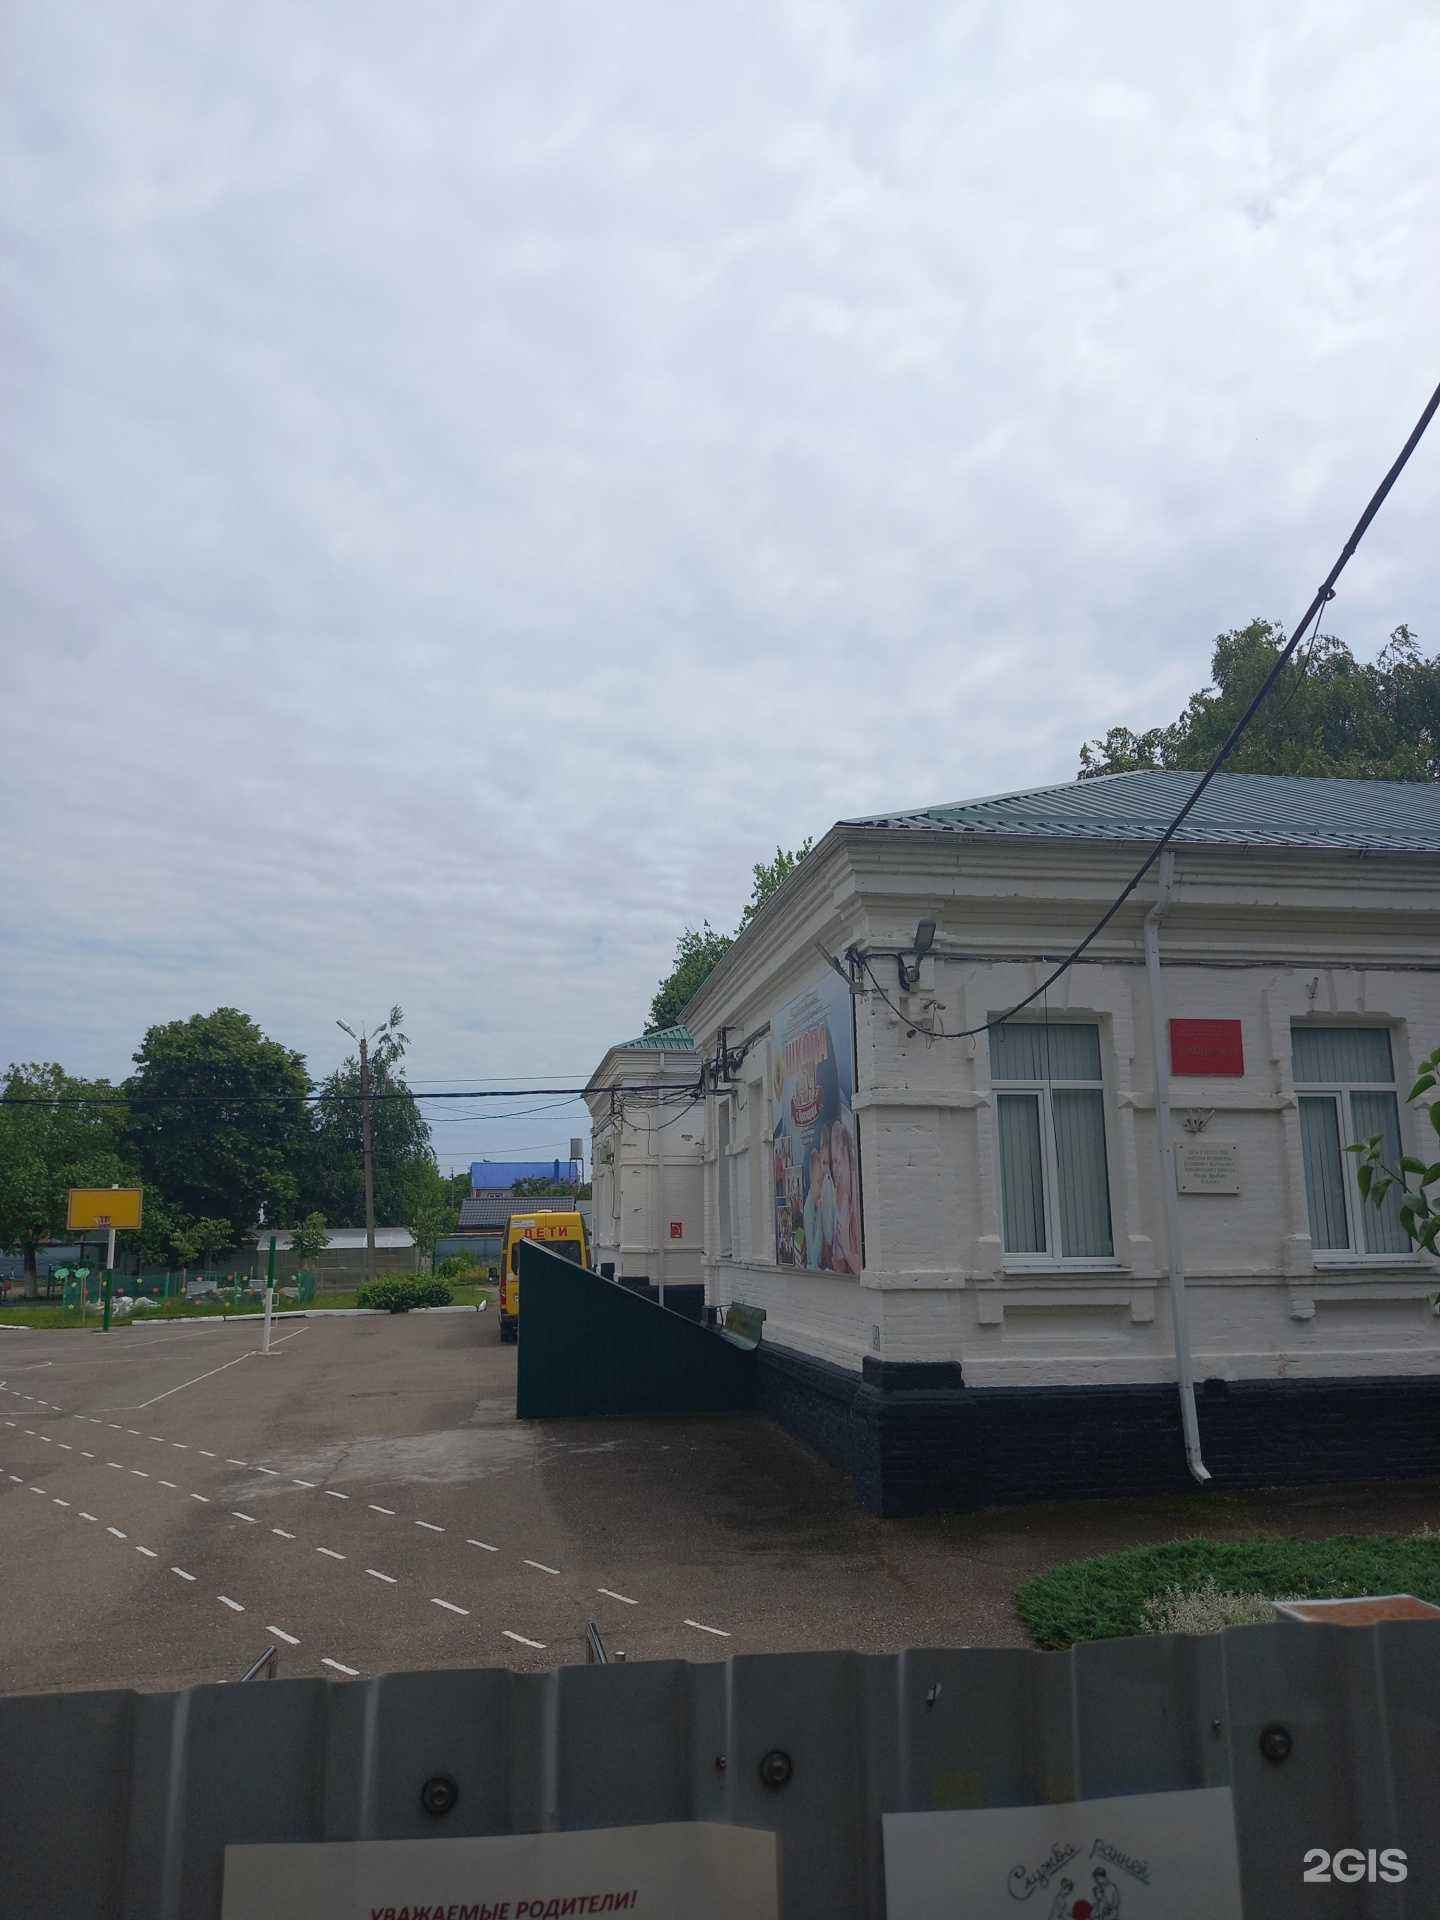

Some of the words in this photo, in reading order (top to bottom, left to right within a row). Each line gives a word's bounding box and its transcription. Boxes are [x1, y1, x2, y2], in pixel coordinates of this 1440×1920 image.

[523, 1225, 568, 1239] ДЕТИ
[369, 1902, 511, 1920] УВАЖАЕМЫЕ
[514, 1889, 639, 1919] РОДИТЕЛИ!
